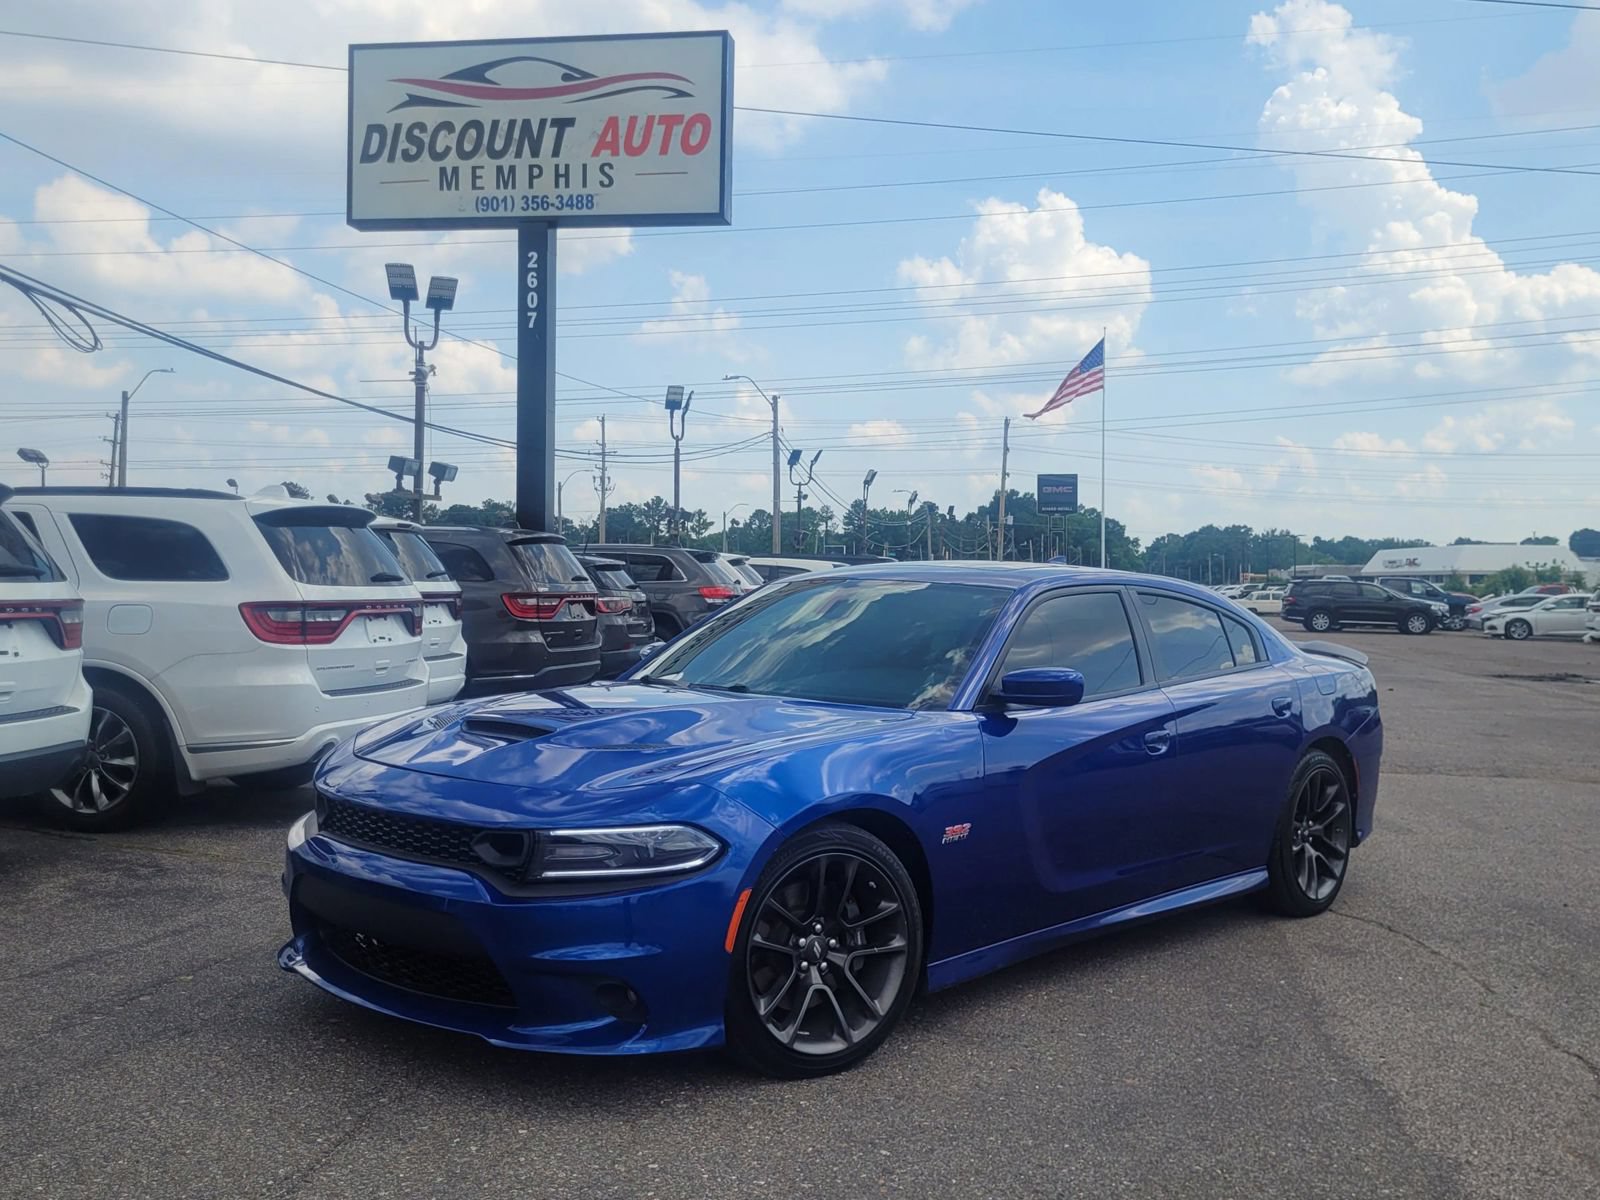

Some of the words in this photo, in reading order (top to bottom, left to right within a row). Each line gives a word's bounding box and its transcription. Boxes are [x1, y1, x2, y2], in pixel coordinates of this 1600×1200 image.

[359, 117, 577, 165] DISCOUNT
[590, 112, 712, 158] AUTO
[438, 162, 615, 192] MEMPHIS
[474, 195, 516, 214] (901)
[520, 193, 595, 213] 356-3488
[526, 250, 539, 329] 2607
